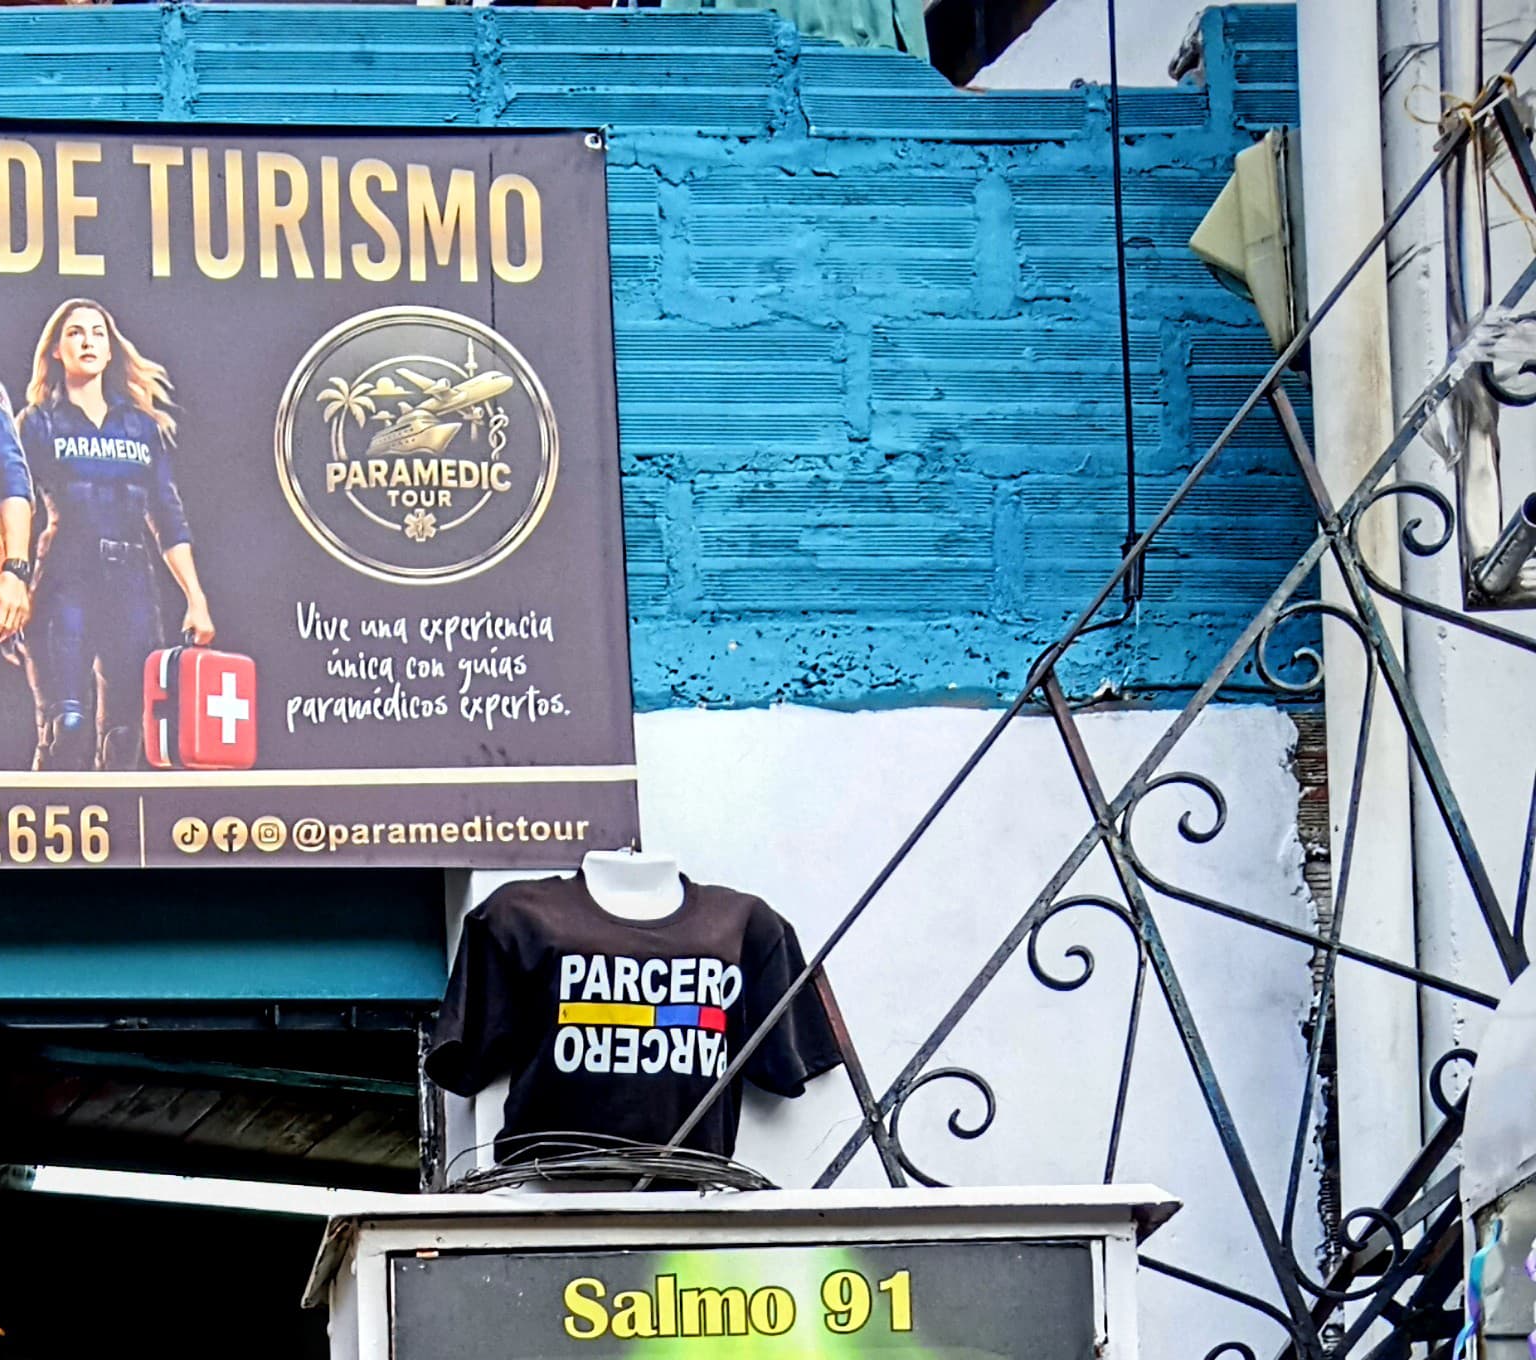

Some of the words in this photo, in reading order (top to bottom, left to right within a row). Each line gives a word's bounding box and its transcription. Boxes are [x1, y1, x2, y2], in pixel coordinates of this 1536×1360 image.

[132, 143, 543, 283] TURISMO
[55, 437, 151, 464] PARAMEDIC
[325, 458, 512, 493] PARAMEDIC
[386, 490, 452, 507] TOUR
[297, 601, 351, 642] Vive
[361, 617, 408, 644] una
[420, 610, 554, 652] experiencia
[327, 648, 394, 683] única
[406, 656, 445, 680] con
[458, 646, 528, 694] guías
[287, 682, 449, 733] paramédicos
[460, 685, 571, 730] expertos.
[291, 815, 590, 853] @paramedictour
[559, 954, 743, 1011] PARCERO
[563, 1274, 797, 1339] Salmo
[820, 1270, 912, 1334] 91
